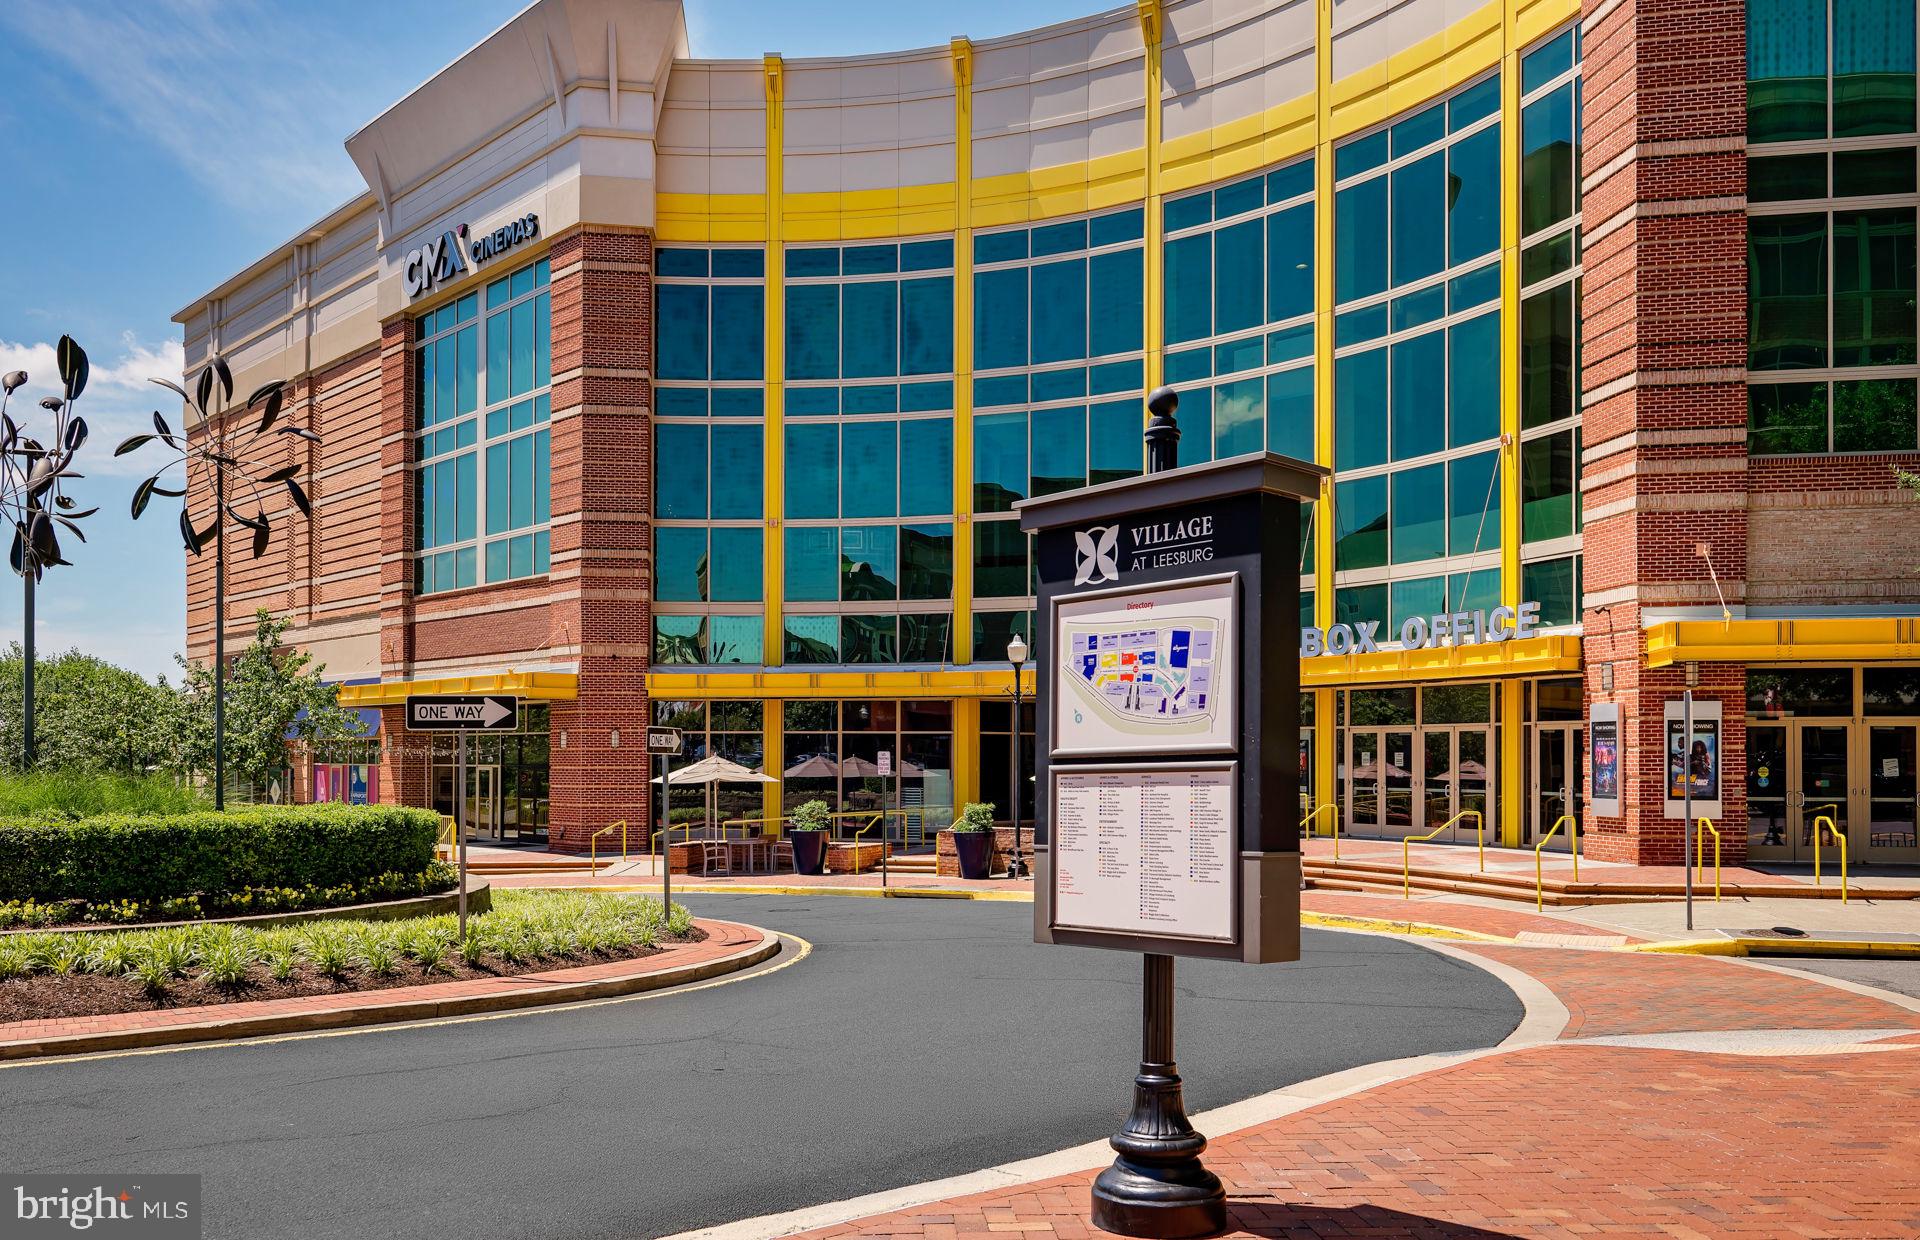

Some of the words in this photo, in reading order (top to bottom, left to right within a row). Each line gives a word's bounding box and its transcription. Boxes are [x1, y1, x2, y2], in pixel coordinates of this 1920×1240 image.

[403, 223, 468, 297] CMX
[471, 213, 538, 263] CINEMAS
[1131, 515, 1213, 546] VILLAGE
[1131, 556, 1146, 571] AT
[1153, 547, 1213, 568] LEESBURG
[1126, 601, 1154, 610] Directory
[1301, 620, 1380, 657] BOX
[1401, 601, 1541, 650] OFFICE
[418, 706, 448, 719] ONE
[454, 706, 484, 719] WAY
[651, 736, 663, 746] ONE
[664, 735, 674, 746] WAY
